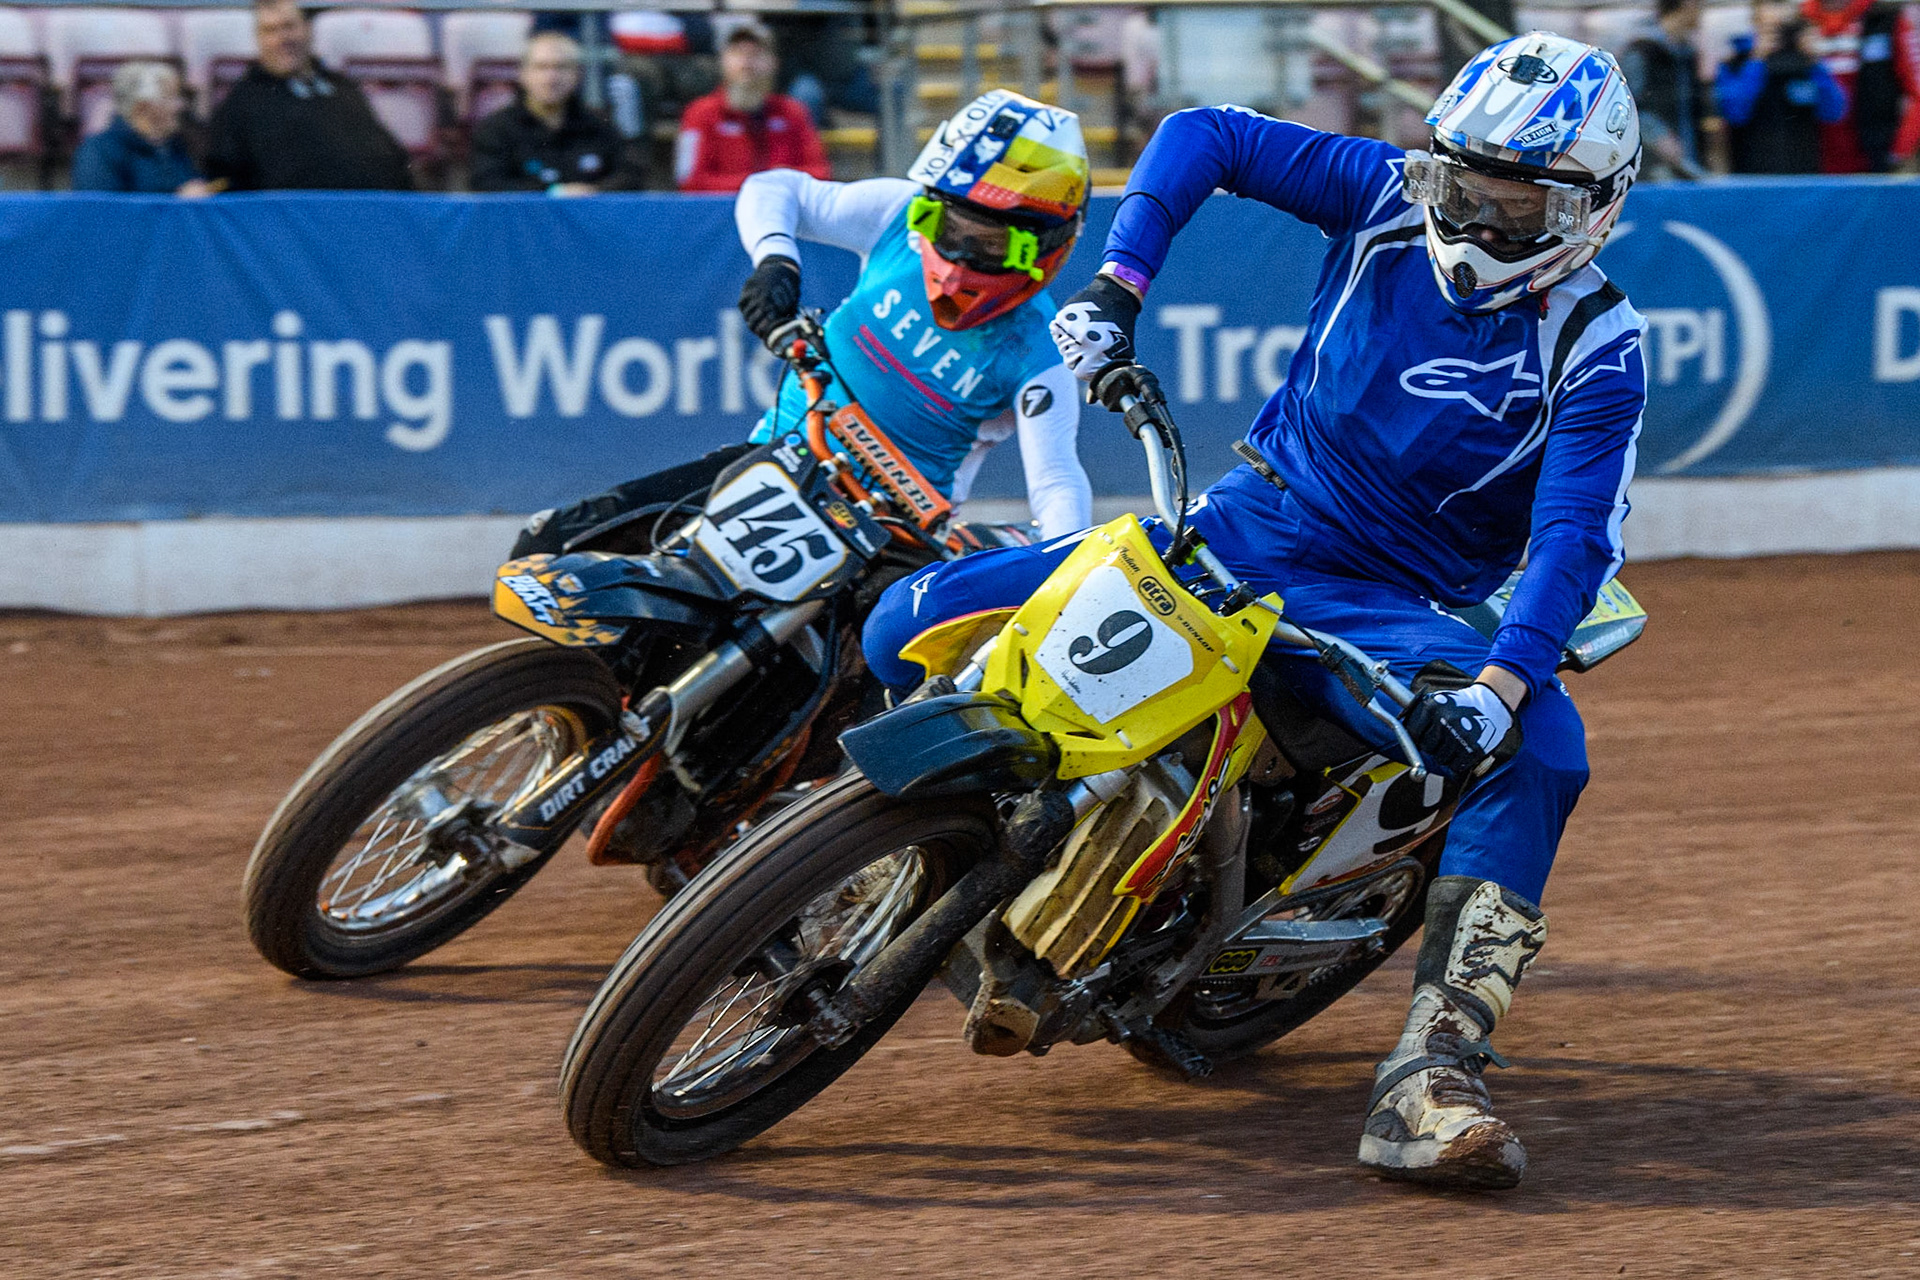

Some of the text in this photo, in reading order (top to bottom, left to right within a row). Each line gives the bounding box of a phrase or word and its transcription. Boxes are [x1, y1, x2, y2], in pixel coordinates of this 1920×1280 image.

[872, 288, 984, 399] SEVEN
[844, 416, 936, 513] RENTHAL
[705, 482, 837, 584] 145
[1068, 609, 1154, 675] 9
[1141, 580, 1173, 612] dtra
[1183, 620, 1215, 653] DUNLOP
[539, 714, 652, 822] DIRT CRA
